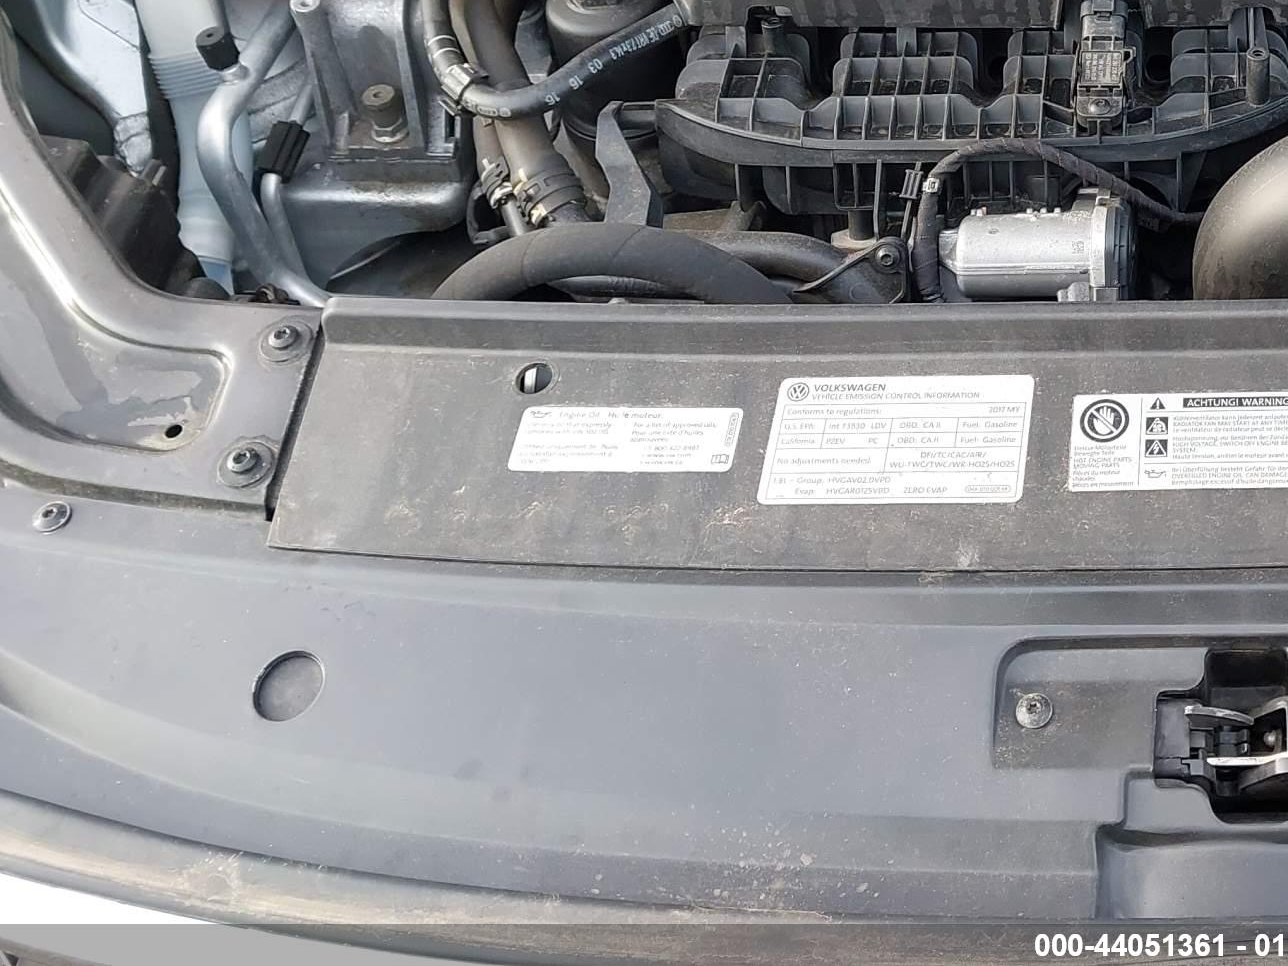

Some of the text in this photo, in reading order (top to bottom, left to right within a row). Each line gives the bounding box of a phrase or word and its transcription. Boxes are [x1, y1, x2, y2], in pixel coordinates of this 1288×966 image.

[813, 383, 887, 392] VOLKSWAGEN
[811, 392, 981, 400] VEHICLE EMISSION CONTROL INFORMATION
[1186, 398, 1239, 407] ACHTUNG!
[607, 411, 629, 419] Hule
[984, 420, 1018, 428] Gasoline
[982, 435, 1017, 443] Gasoline
[790, 456, 839, 465] adjustments
[926, 486, 948, 494] EVAP
